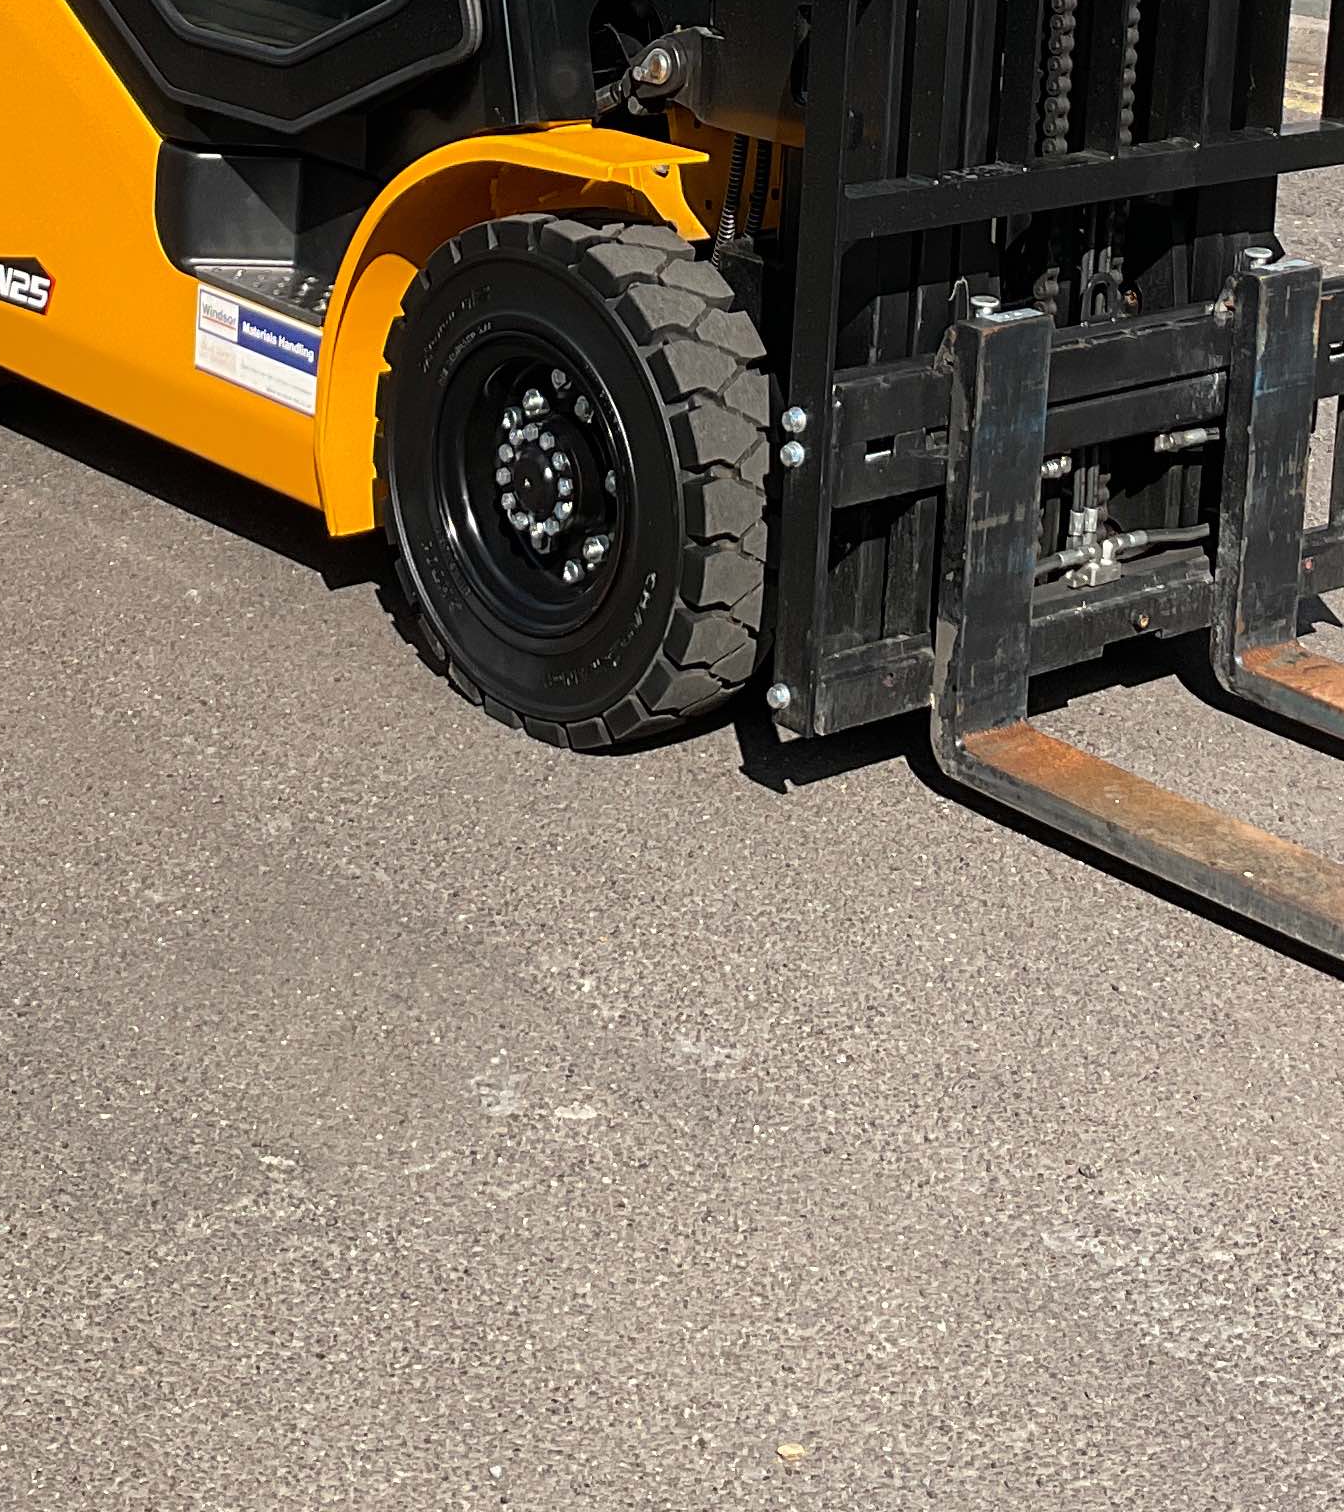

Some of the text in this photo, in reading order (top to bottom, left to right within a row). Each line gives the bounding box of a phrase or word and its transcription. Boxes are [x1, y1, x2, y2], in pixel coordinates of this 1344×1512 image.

[202, 300, 237, 325] Windsor
[242, 320, 315, 363] Materials Handling
